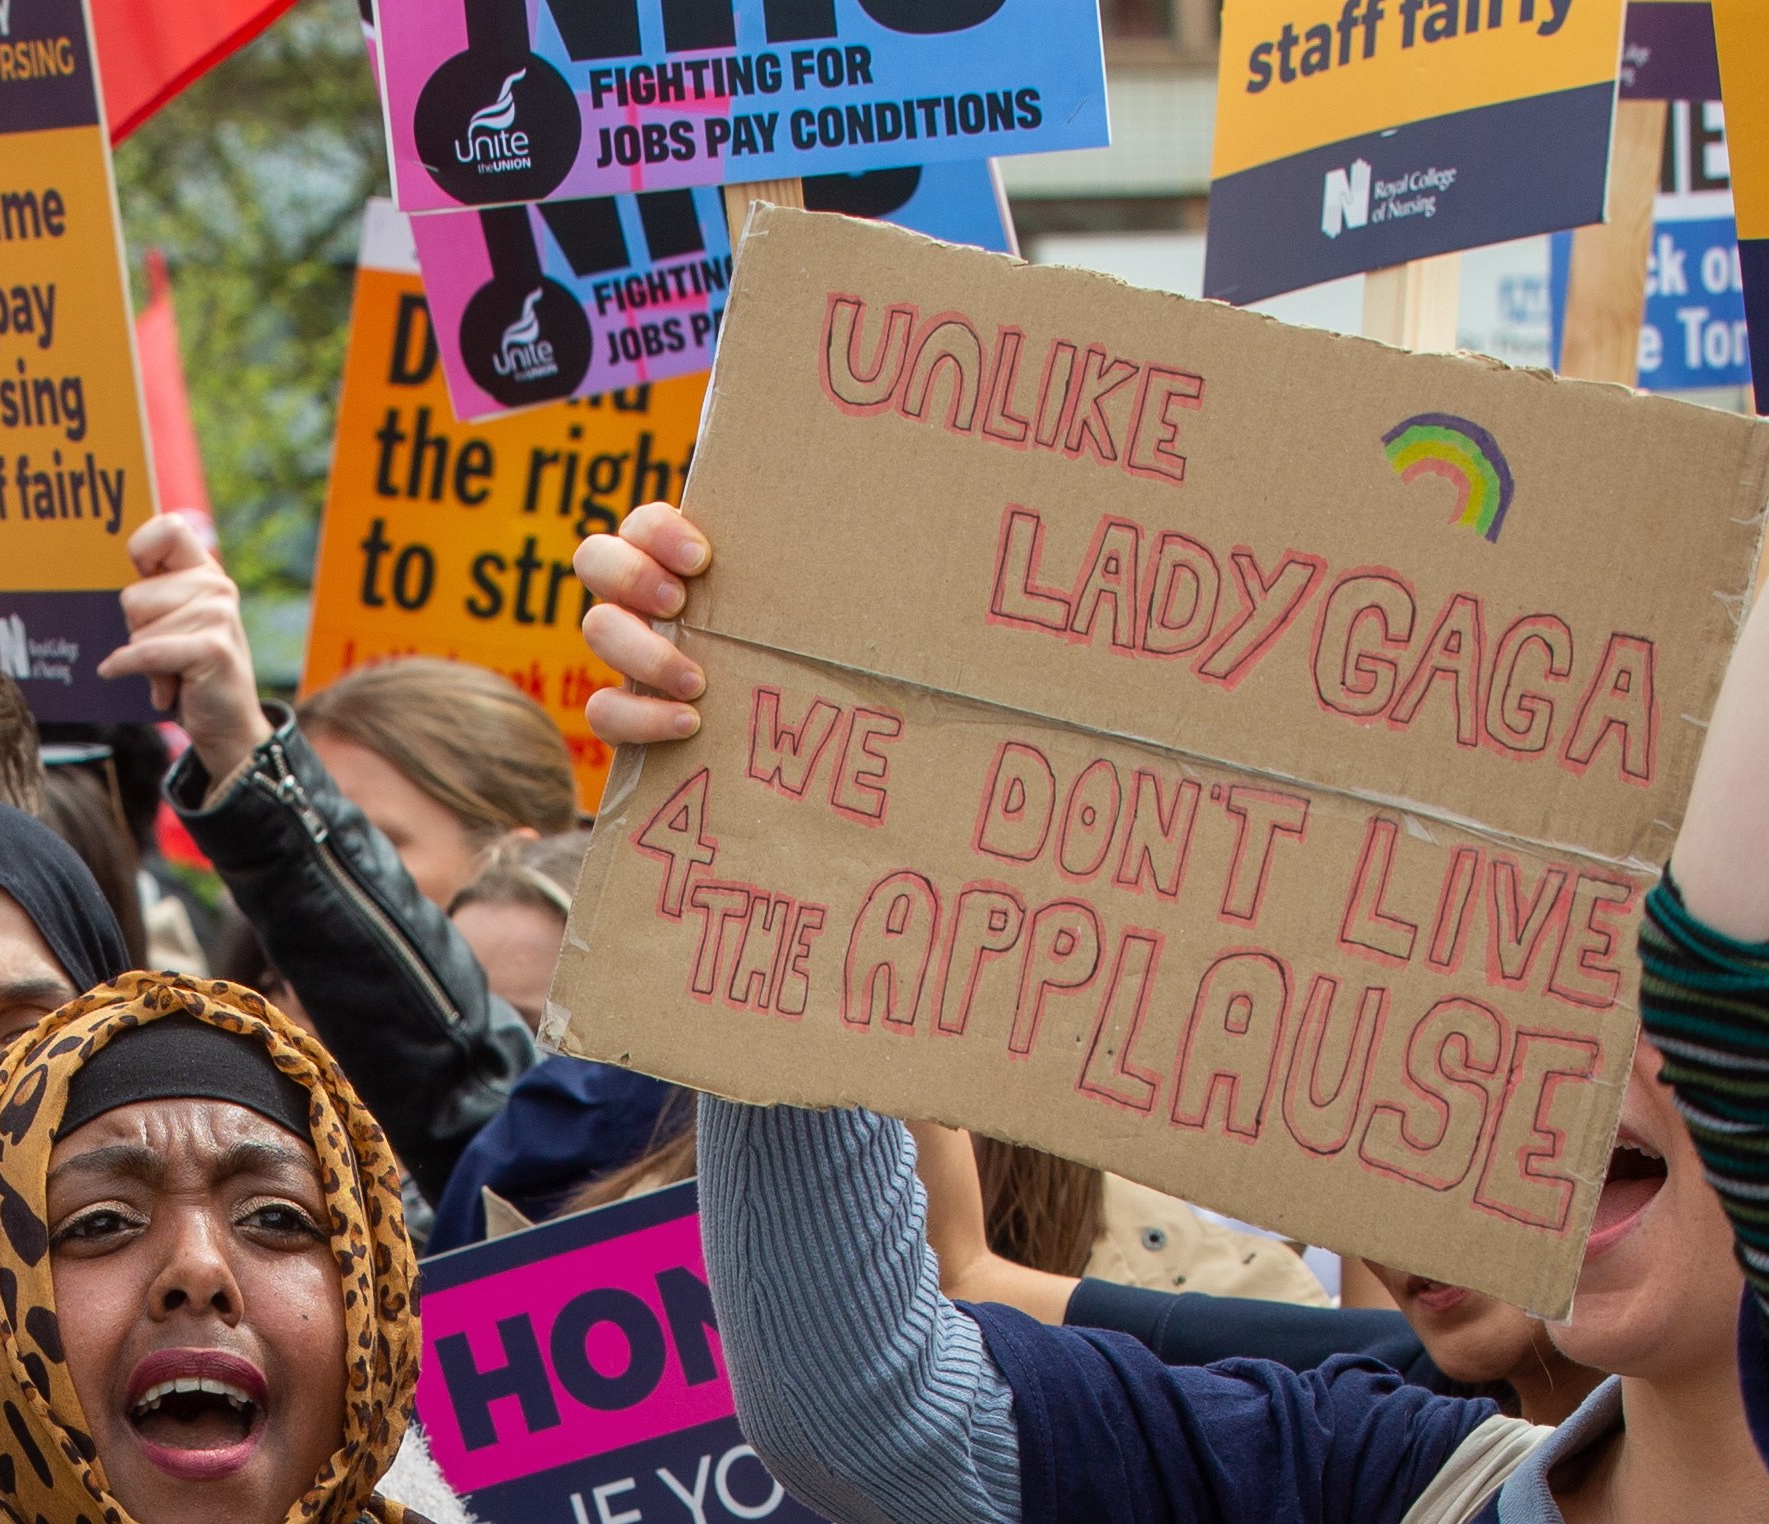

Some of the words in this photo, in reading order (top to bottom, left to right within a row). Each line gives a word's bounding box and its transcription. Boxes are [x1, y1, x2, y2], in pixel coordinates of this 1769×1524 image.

[588, 53, 782, 110] FIGHTING
[791, 45, 873, 91] FOR
[1245, 0, 1384, 94] staff
[596, 120, 697, 168] JOBS
[704, 112, 780, 158] PAY
[790, 87, 1042, 150] CONDITIONS
[1371, 201, 1386, 223] of
[1387, 194, 1437, 218] Nursing
[1374, 173, 1408, 200] Royal
[1409, 167, 1457, 192] College
[606, 317, 685, 365] JOBS
[819, 292, 1205, 486] UNLIKE
[15, 448, 125, 534] fairly
[375, 405, 496, 508] the
[361, 518, 438, 611] to
[744, 685, 906, 828] WE
[971, 736, 1310, 928] DON'T
[1338, 818, 1639, 1009] LIVE
[632, 766, 718, 921] 4
[687, 881, 827, 1022] THE
[841, 868, 1600, 1233] APPLAUSE
